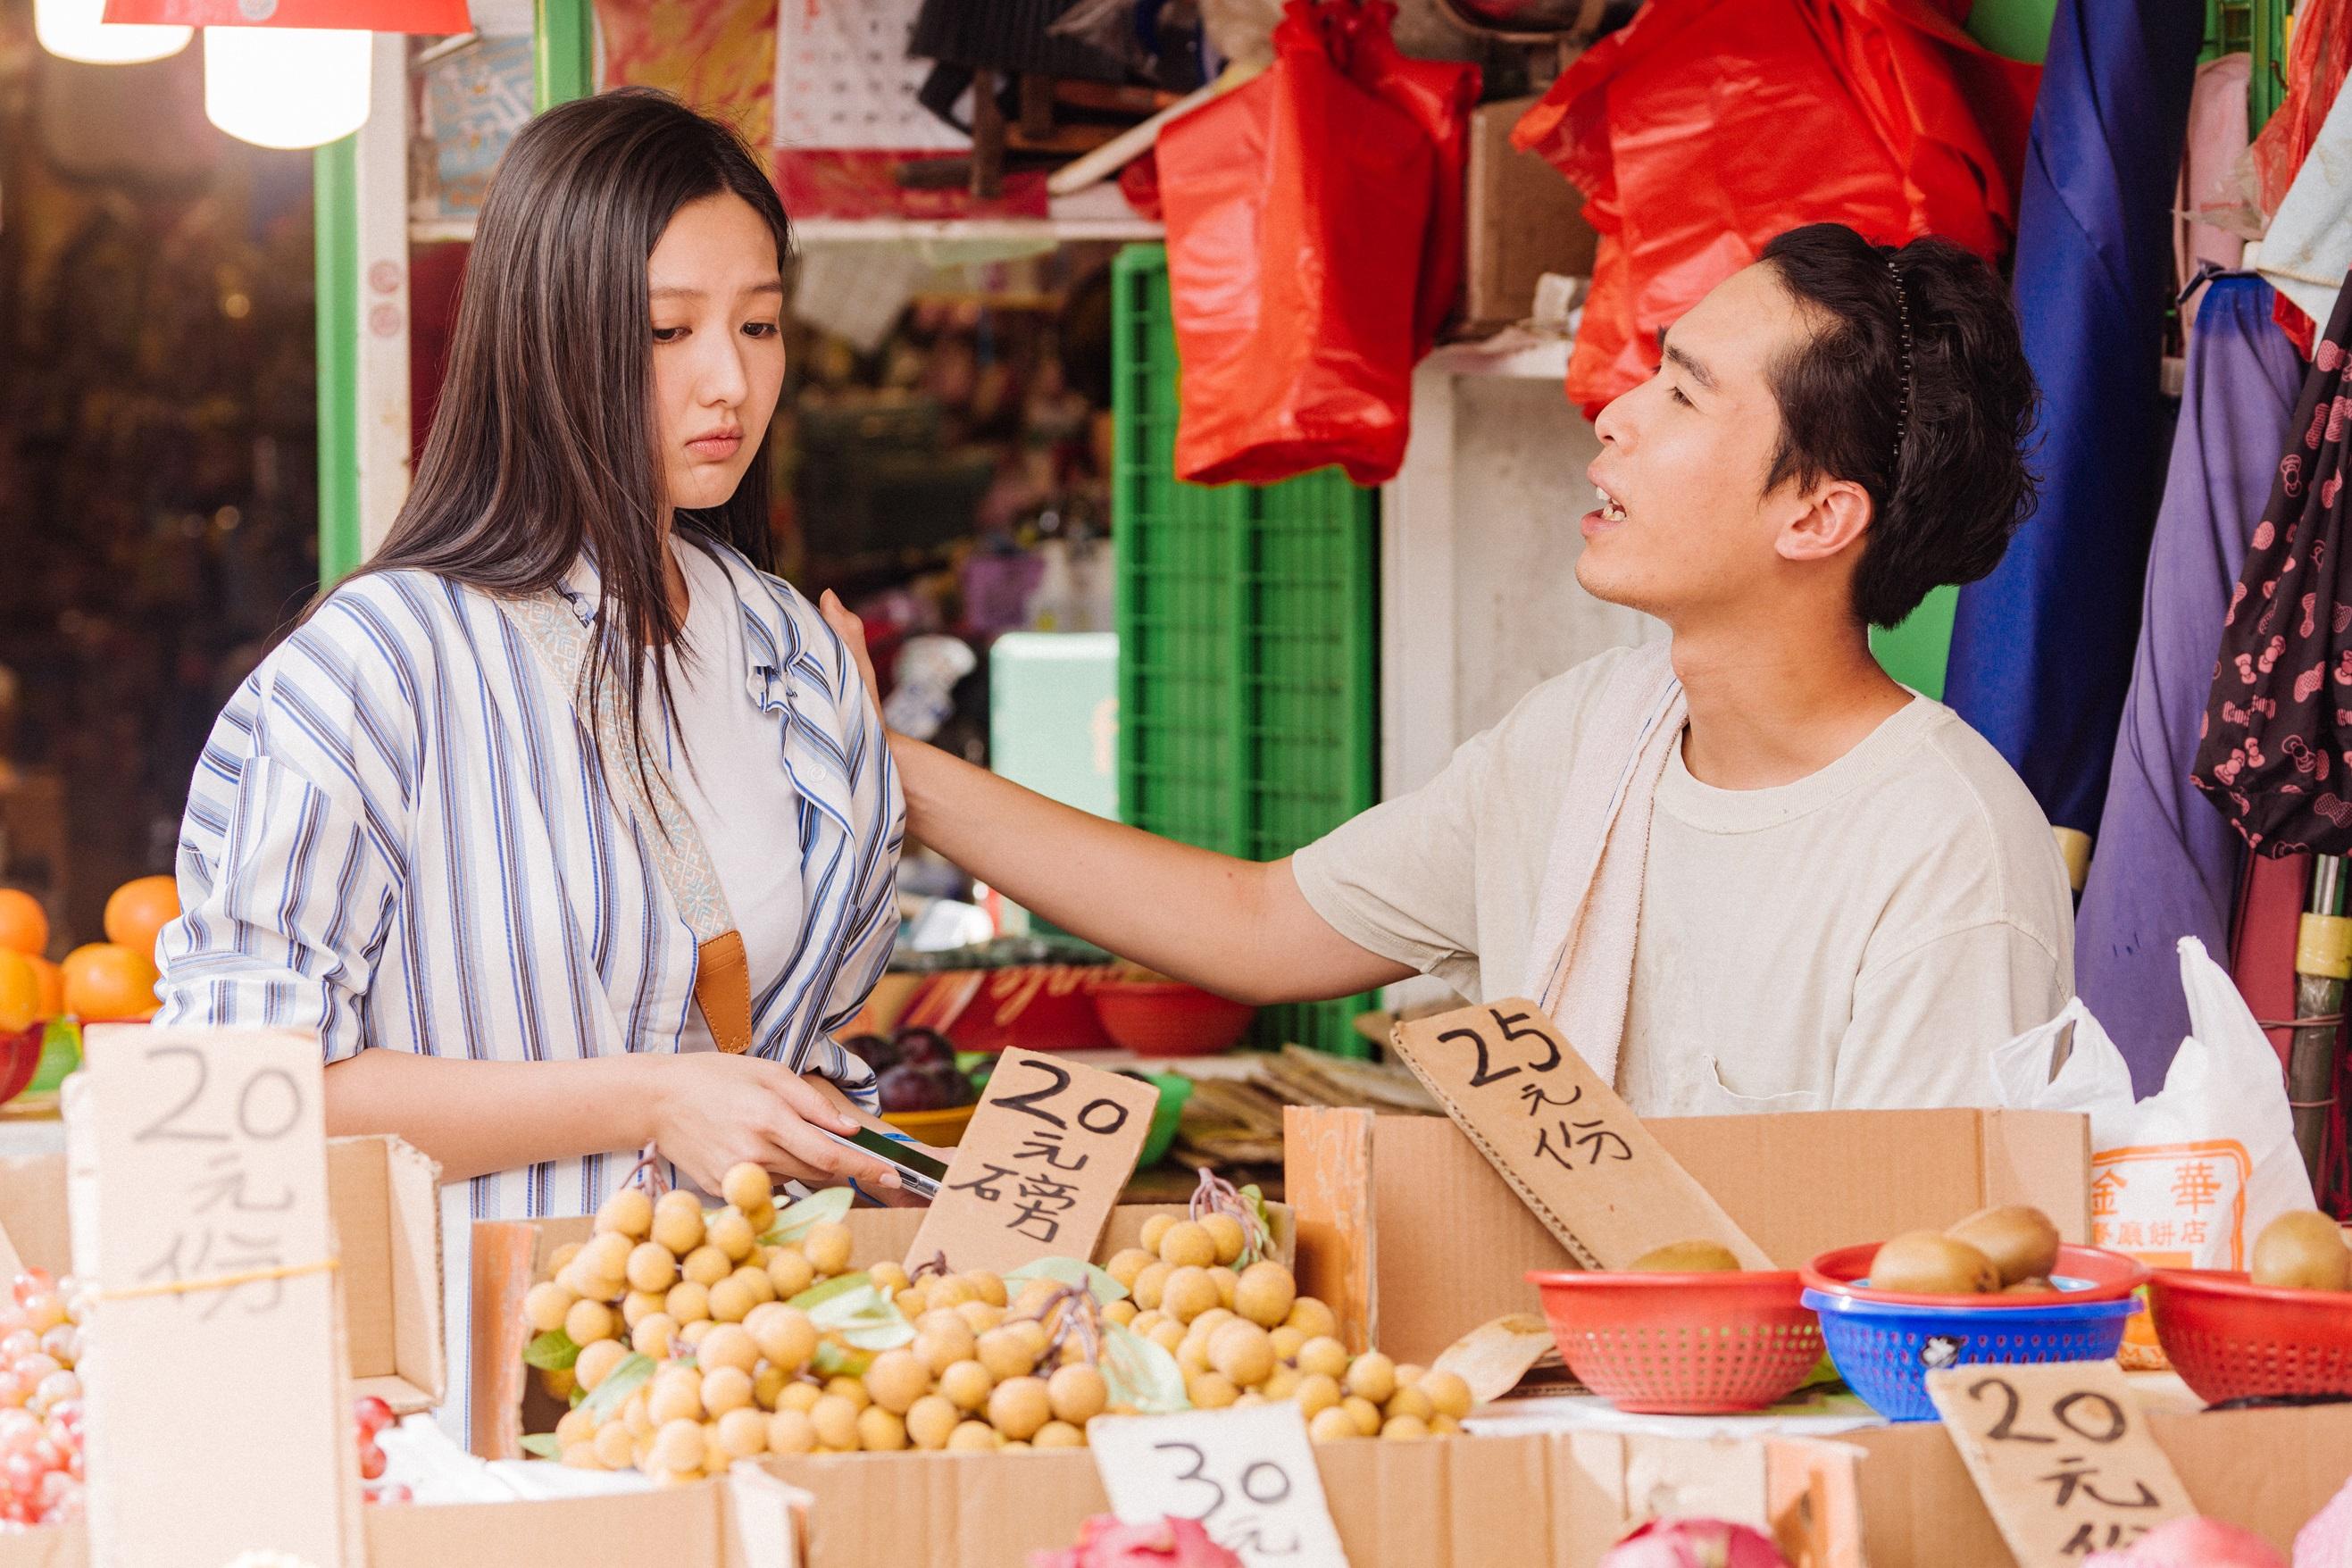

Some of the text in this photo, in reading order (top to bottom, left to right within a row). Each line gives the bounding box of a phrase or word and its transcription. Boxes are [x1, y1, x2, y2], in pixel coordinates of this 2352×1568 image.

[1437, 1008, 1562, 1088] 25
[134, 1047, 302, 1143] 20
[989, 1059, 1129, 1135] 20
[1520, 1083, 1581, 1116] 元
[1013, 1130, 1089, 1171] 元
[1533, 1120, 1632, 1170] 份
[189, 1152, 296, 1214] 元
[948, 1163, 1080, 1243] 磅
[138, 1228, 285, 1321] 份
[1968, 1378, 2126, 1444] 20
[1154, 1442, 1289, 1518] 30
[2038, 1455, 2161, 1507] 元
